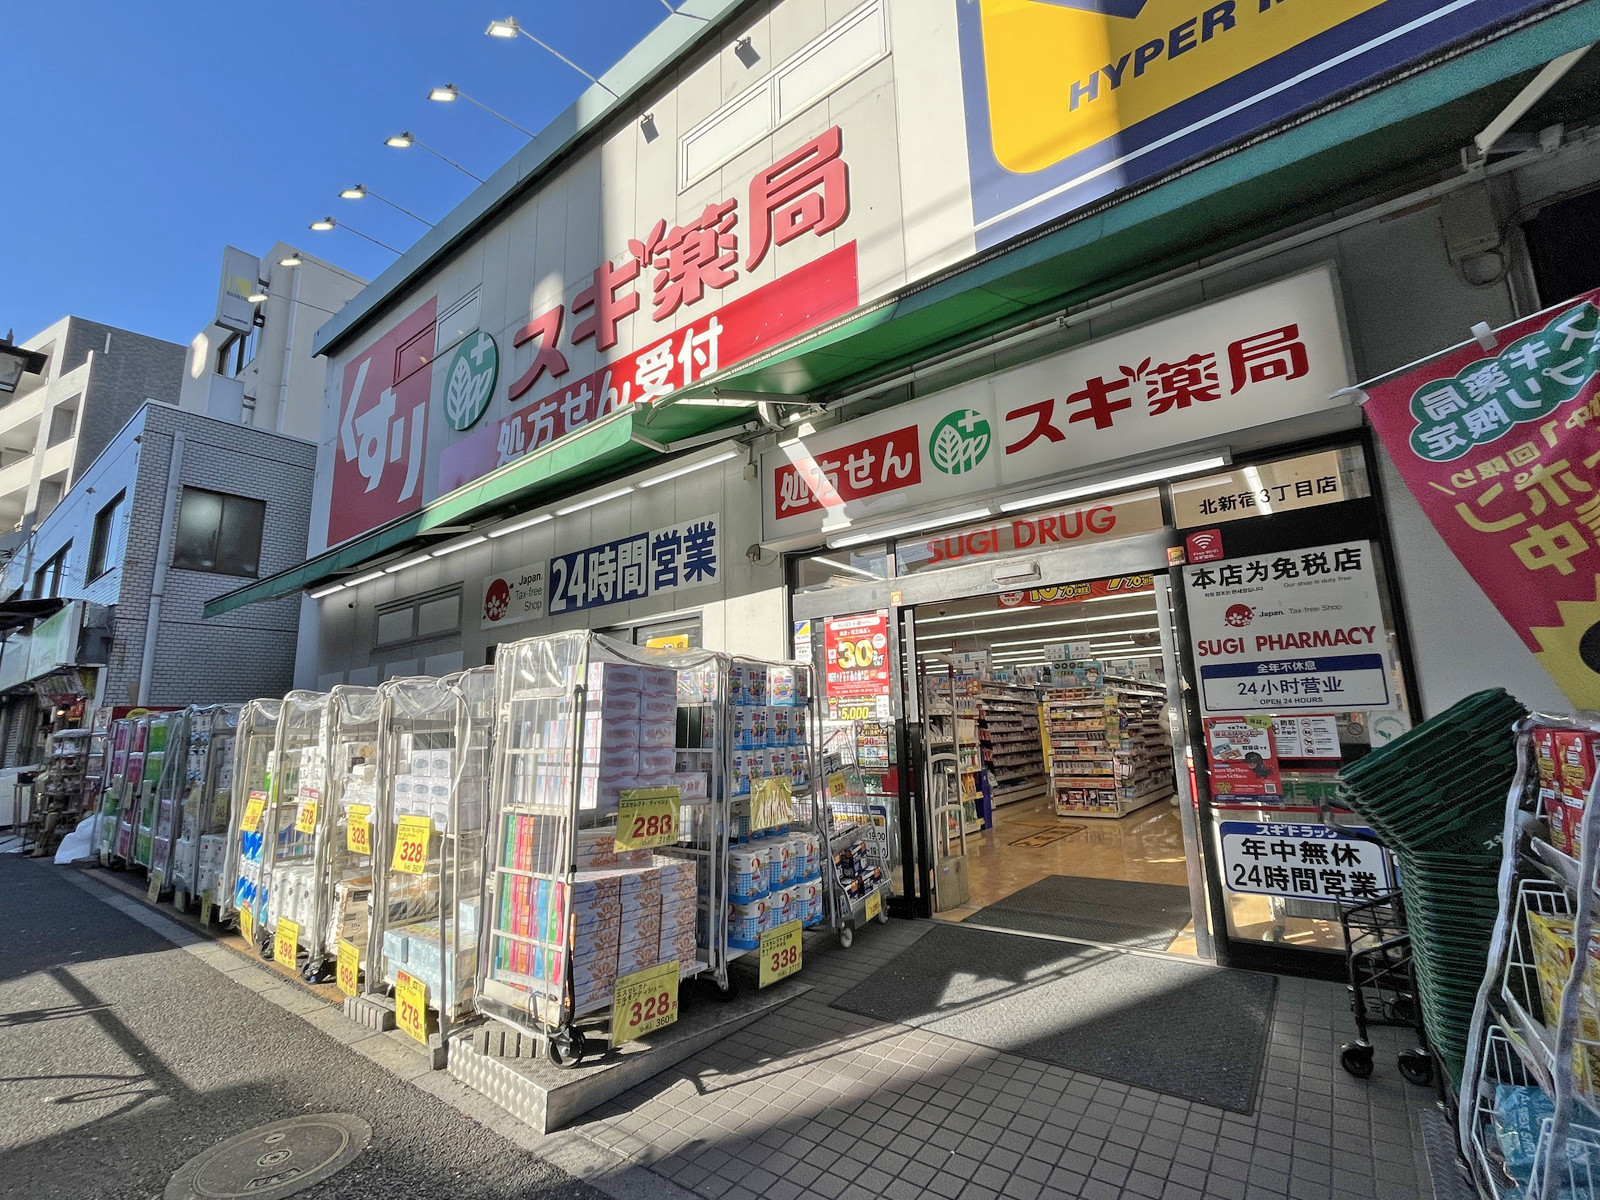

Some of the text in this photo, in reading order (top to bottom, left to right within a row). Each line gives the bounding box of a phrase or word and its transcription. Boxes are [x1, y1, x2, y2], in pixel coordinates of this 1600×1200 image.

[1069, 0, 1236, 112] HYPER
[508, 125, 852, 402] スギ薬局
[1005, 322, 1310, 456] スギ薬局
[340, 357, 426, 504] くすり
[780, 445, 914, 511] 処方せん
[1198, 476, 1338, 516] 北新宿3丁目店
[927, 503, 1117, 565] SUGI DRUG
[550, 520, 718, 612] 24時間営業
[1191, 548, 1362, 590] 本店为免税店
[515, 587, 543, 600] Tax-free
[1297, 580, 1313, 588] shop
[524, 600, 543, 612] Shop
[1289, 606, 1320, 615] Tax-free
[1322, 604, 1343, 612] Shop
[1197, 625, 1377, 657] SUGI PHARMACY
[1256, 660, 1317, 673] 全年不休息
[1237, 676, 1344, 696] 24小时营业
[1259, 698, 1282, 706] OPEN
[1294, 696, 1324, 704] HOURS
[1256, 824, 1338, 839] スギドラッグ
[400, 841, 423, 863] 328
[1241, 837, 1362, 867] 年中無休
[1232, 863, 1380, 900] 24時間営業
